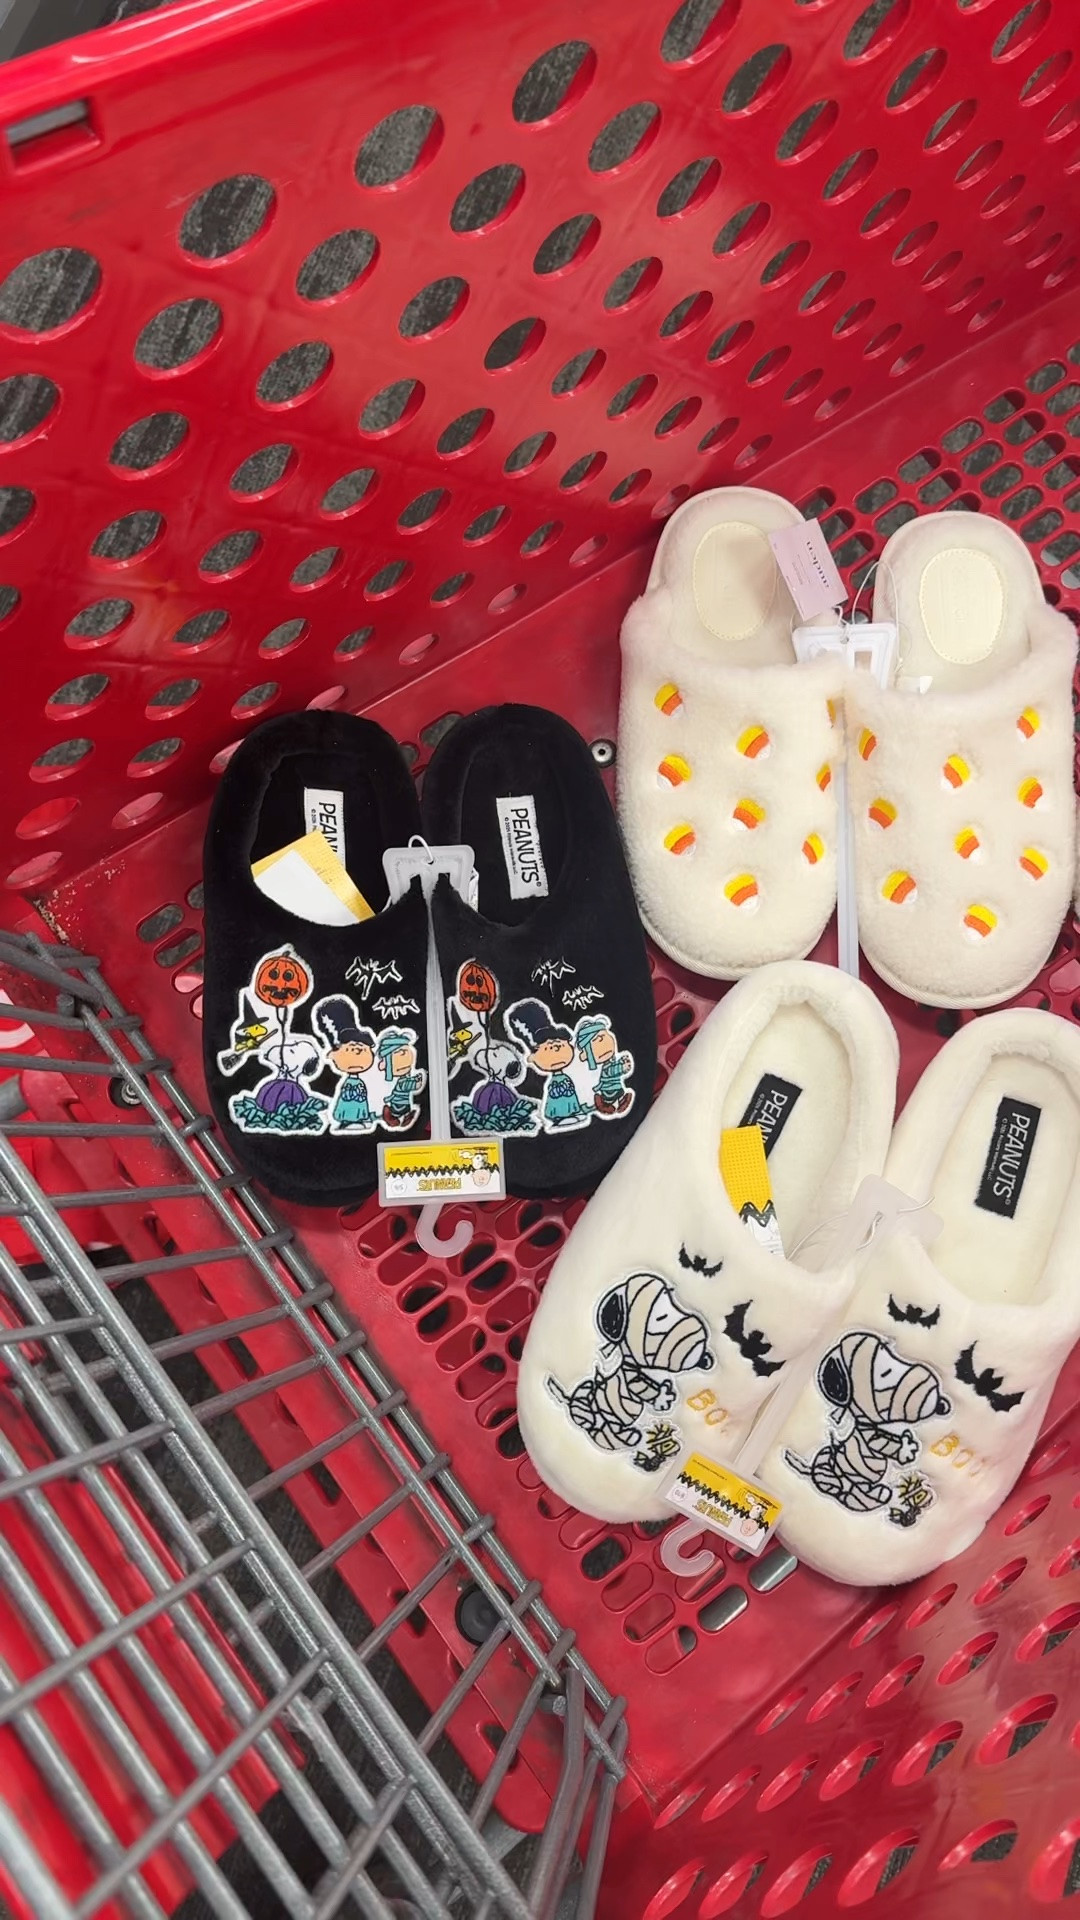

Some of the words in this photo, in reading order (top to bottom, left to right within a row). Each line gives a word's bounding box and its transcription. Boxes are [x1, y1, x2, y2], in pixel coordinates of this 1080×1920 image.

[511, 807, 540, 884] PEANUTS
[756, 1089, 788, 1144] PEAN
[992, 1112, 1031, 1198] PEANUTS
[686, 1388, 729, 1433] BO
